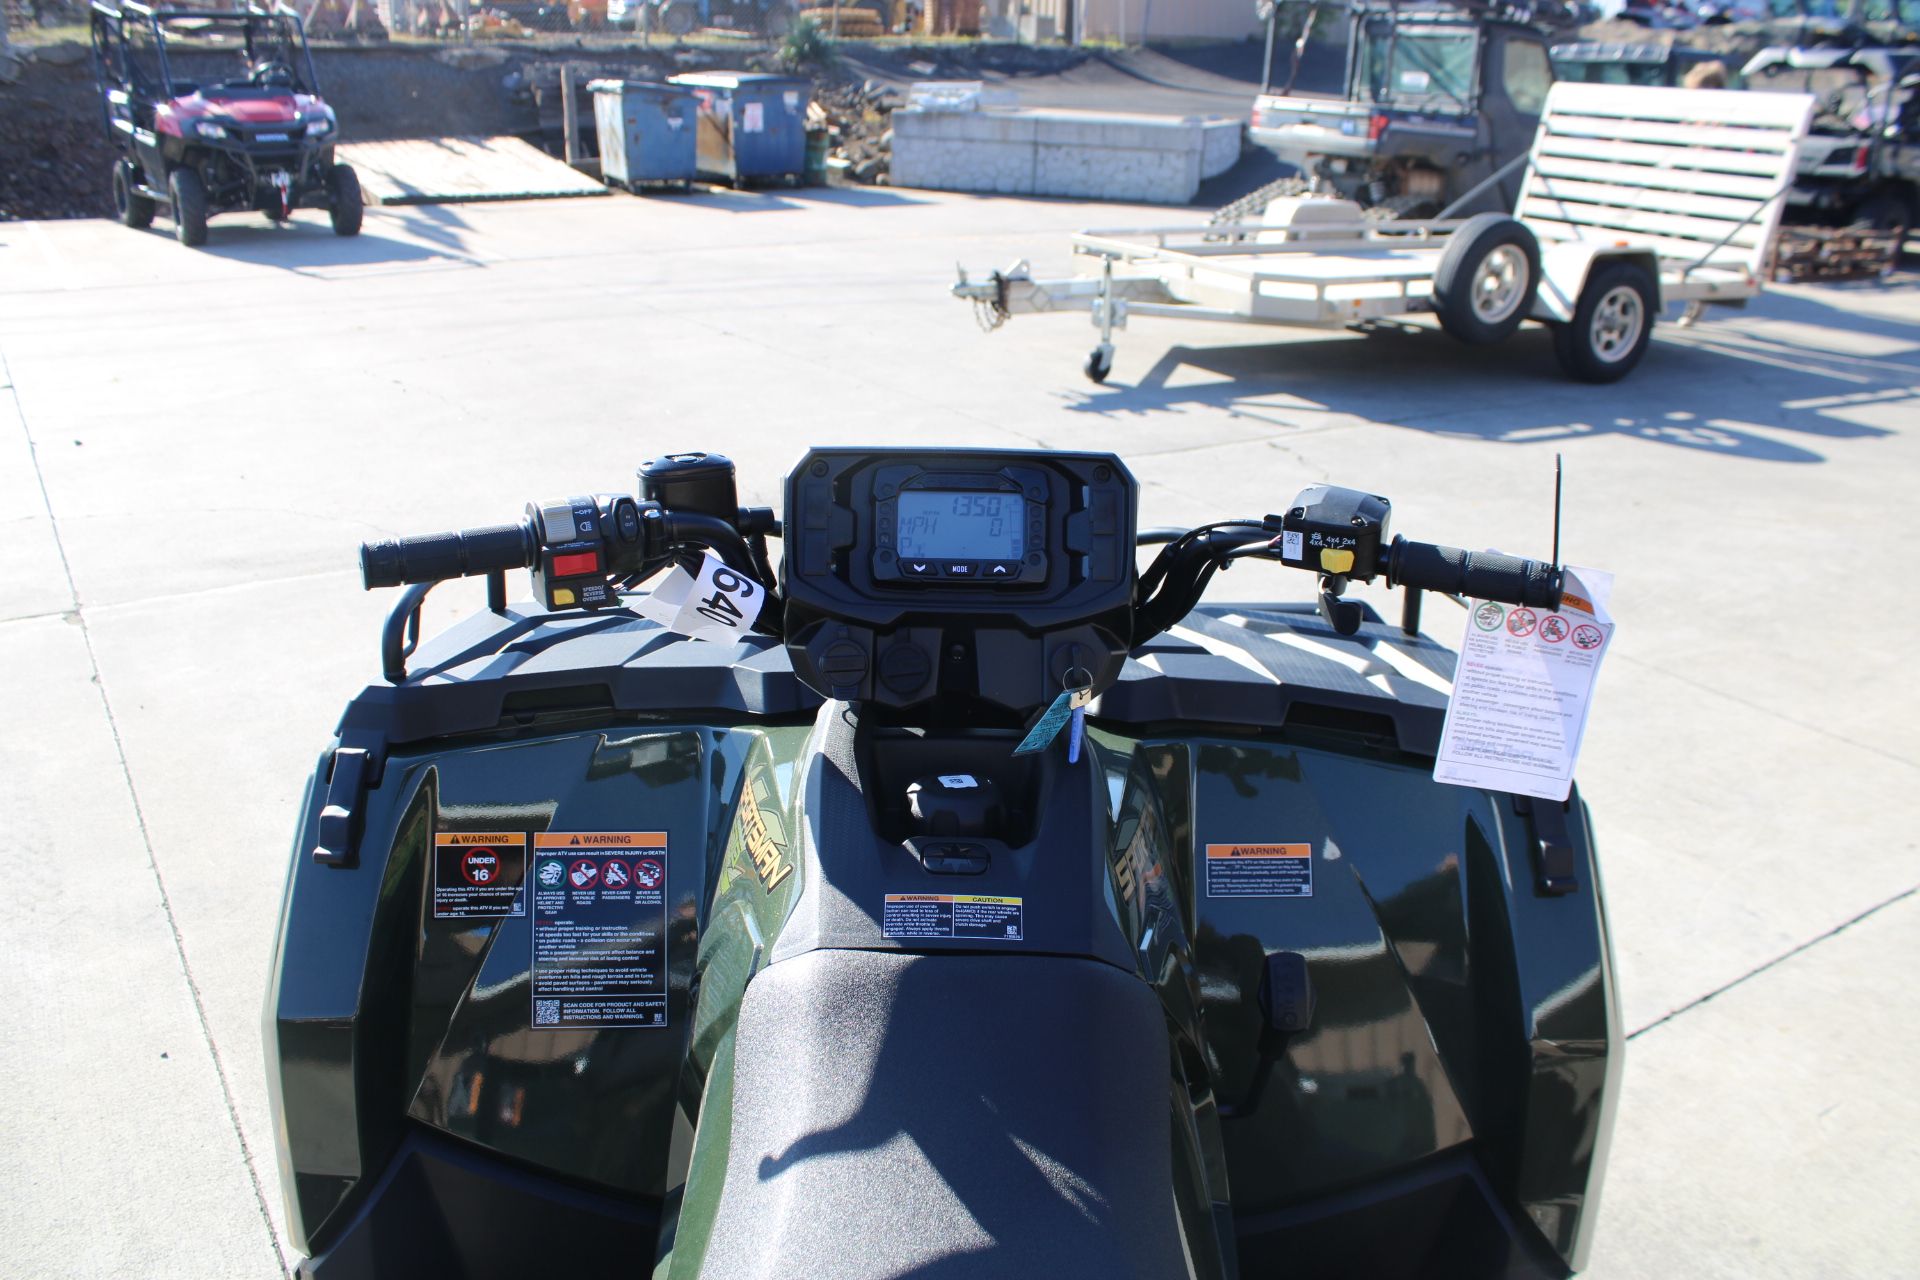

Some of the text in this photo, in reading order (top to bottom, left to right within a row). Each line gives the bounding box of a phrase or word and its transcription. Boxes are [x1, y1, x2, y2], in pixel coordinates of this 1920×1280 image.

[953, 496, 1002, 516] 1350
[899, 517, 1003, 536] MPH 0
[696, 568, 754, 627] 640
[462, 835, 508, 843] WARNING
[584, 836, 631, 844] WARNING
[472, 869, 489, 881] 16
